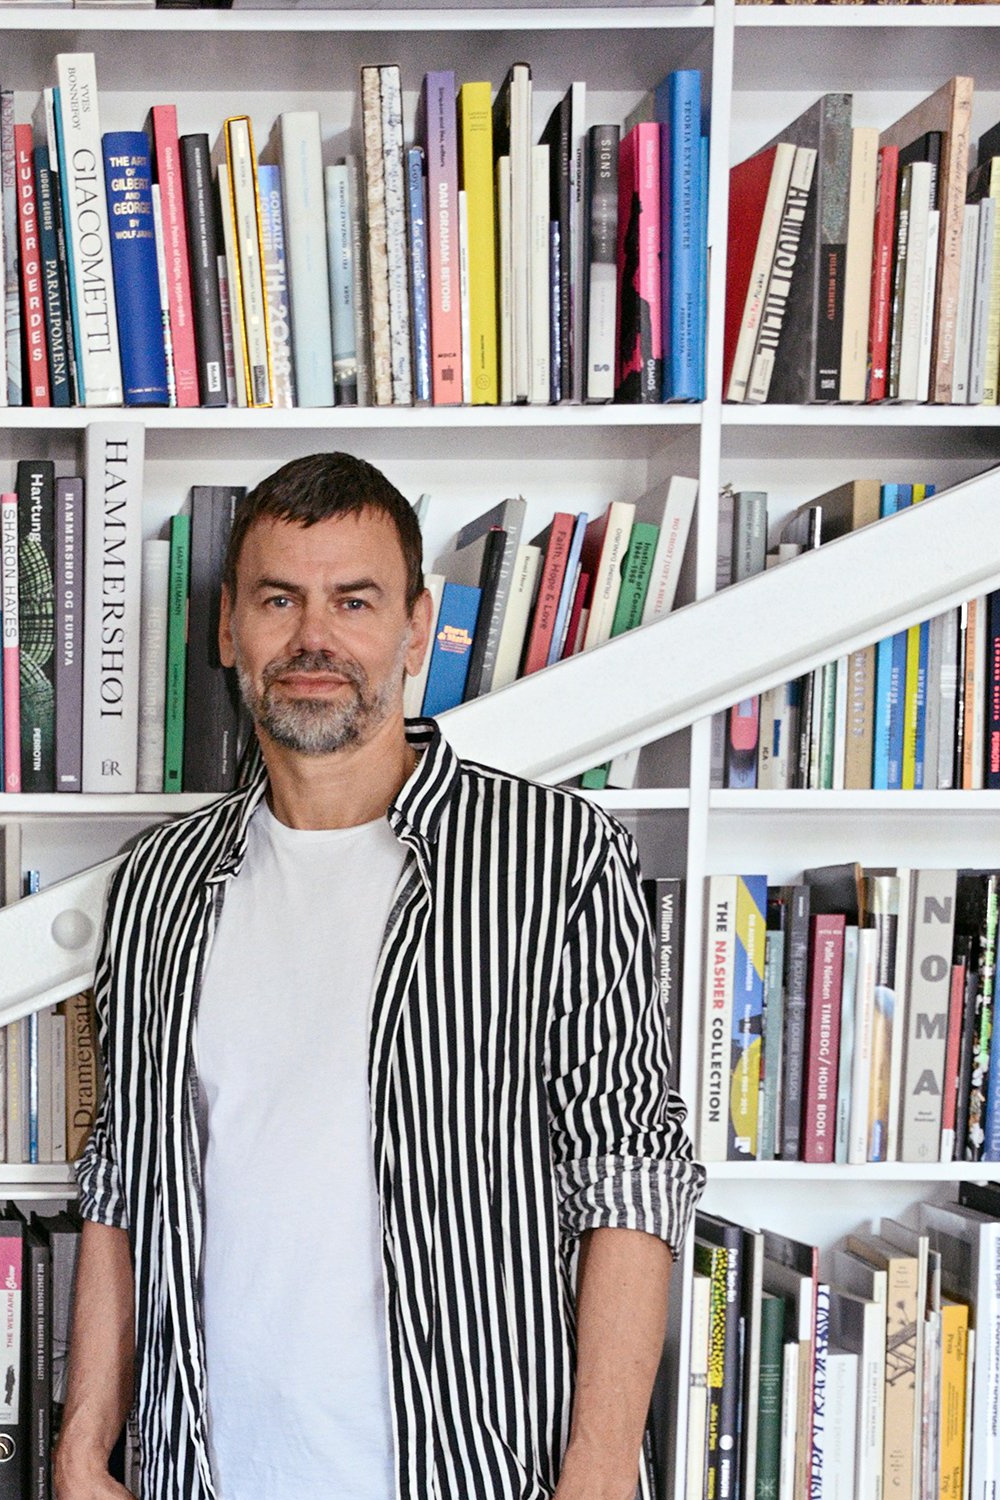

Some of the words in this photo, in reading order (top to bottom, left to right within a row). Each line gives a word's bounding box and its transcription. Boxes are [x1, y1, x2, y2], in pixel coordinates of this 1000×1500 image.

[67, 67, 81, 131] BONNEFOY
[80, 84, 92, 114] YVES
[682, 100, 693, 143] TEORIA
[109, 156, 129, 167] THE
[125, 168, 136, 176] OF
[600, 140, 611, 179] SIGNS
[18, 150, 38, 252] LUDGER
[40, 169, 51, 199] LUDGER
[111, 178, 148, 191] GILBERT
[125, 192, 141, 200] AND
[439, 183, 449, 208] DAN
[42, 201, 53, 231] GERDES
[113, 202, 150, 215] GEORGE
[270, 190, 282, 250] GONZALEZ
[115, 230, 137, 239] WOLF
[773, 186, 810, 279] ALMOST
[72, 148, 112, 357] GIACOMETTI
[440, 267, 451, 312] BEYOND
[25, 262, 43, 362] GERDES
[45, 260, 66, 385] PARALIPOMENA
[757, 294, 789, 357] HERE
[208, 364, 219, 391] MoMA
[28, 474, 45, 543] Hartung
[3, 509, 17, 579] SHARON
[63, 493, 74, 586] HAMMERSHØI
[174, 547, 184, 570] MARY
[499, 525, 518, 582] DAVID
[552, 531, 568, 560] Faith,
[545, 563, 562, 591] Hope
[636, 542, 653, 580] Institute
[99, 439, 129, 722] HAMMERSHØI
[603, 563, 617, 600] CRUISING
[4, 586, 18, 638] HAYES
[63, 590, 74, 610] OG
[540, 605, 553, 630] Love
[63, 614, 74, 666] EUROPA
[482, 591, 505, 671] HOCKNEY
[32, 728, 42, 770] PERROTIN
[660, 894, 673, 943] William
[715, 902, 728, 932] THE
[823, 941, 835, 963] Palle
[713, 941, 726, 1010] NASHER
[822, 965, 834, 1000] Nielsen
[819, 1003, 832, 1056] TIMEBOG
[709, 1018, 724, 1123] COLLECTION
[817, 1066, 829, 1099] HOUR
[815, 1104, 828, 1137] BOOK
[729, 1248, 739, 1268] Park
[5, 1331, 14, 1348] THE
